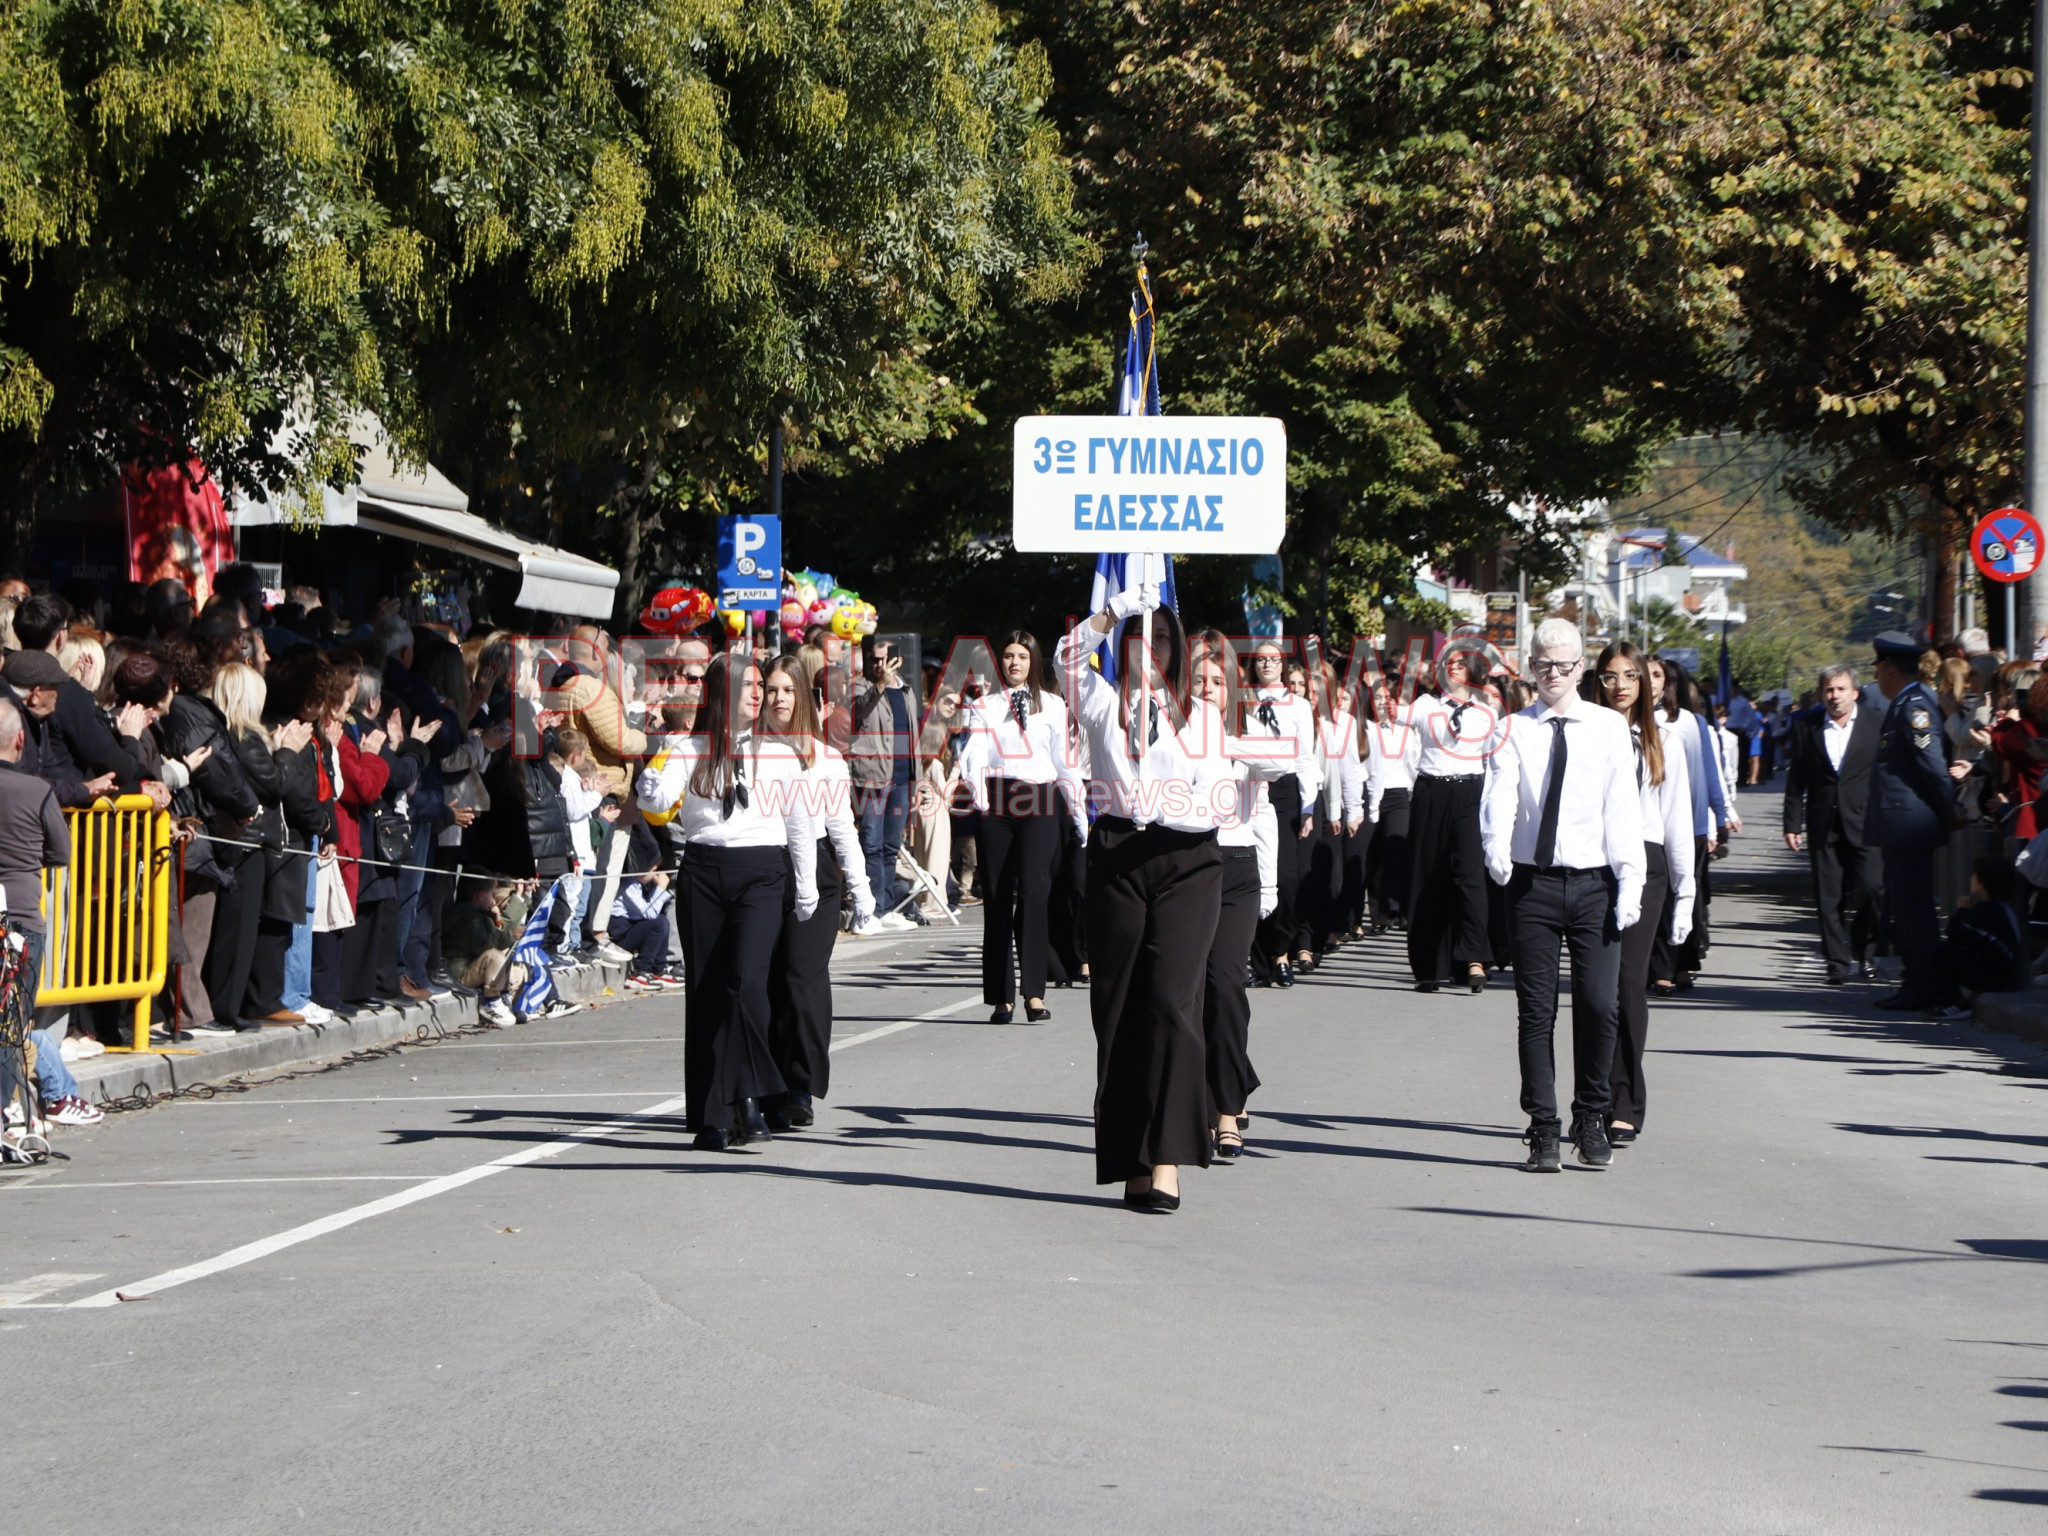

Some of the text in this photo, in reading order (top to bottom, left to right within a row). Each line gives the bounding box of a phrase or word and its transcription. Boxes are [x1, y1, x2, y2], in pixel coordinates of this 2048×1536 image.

[1088, 437, 1264, 476] ΓΥΜΝΑΣΙΟ
[1074, 493, 1224, 532] ΕΔΕΣΣΑΣ
[735, 522, 766, 564] P
[743, 590, 768, 598] ΚΑΡΤΑ
